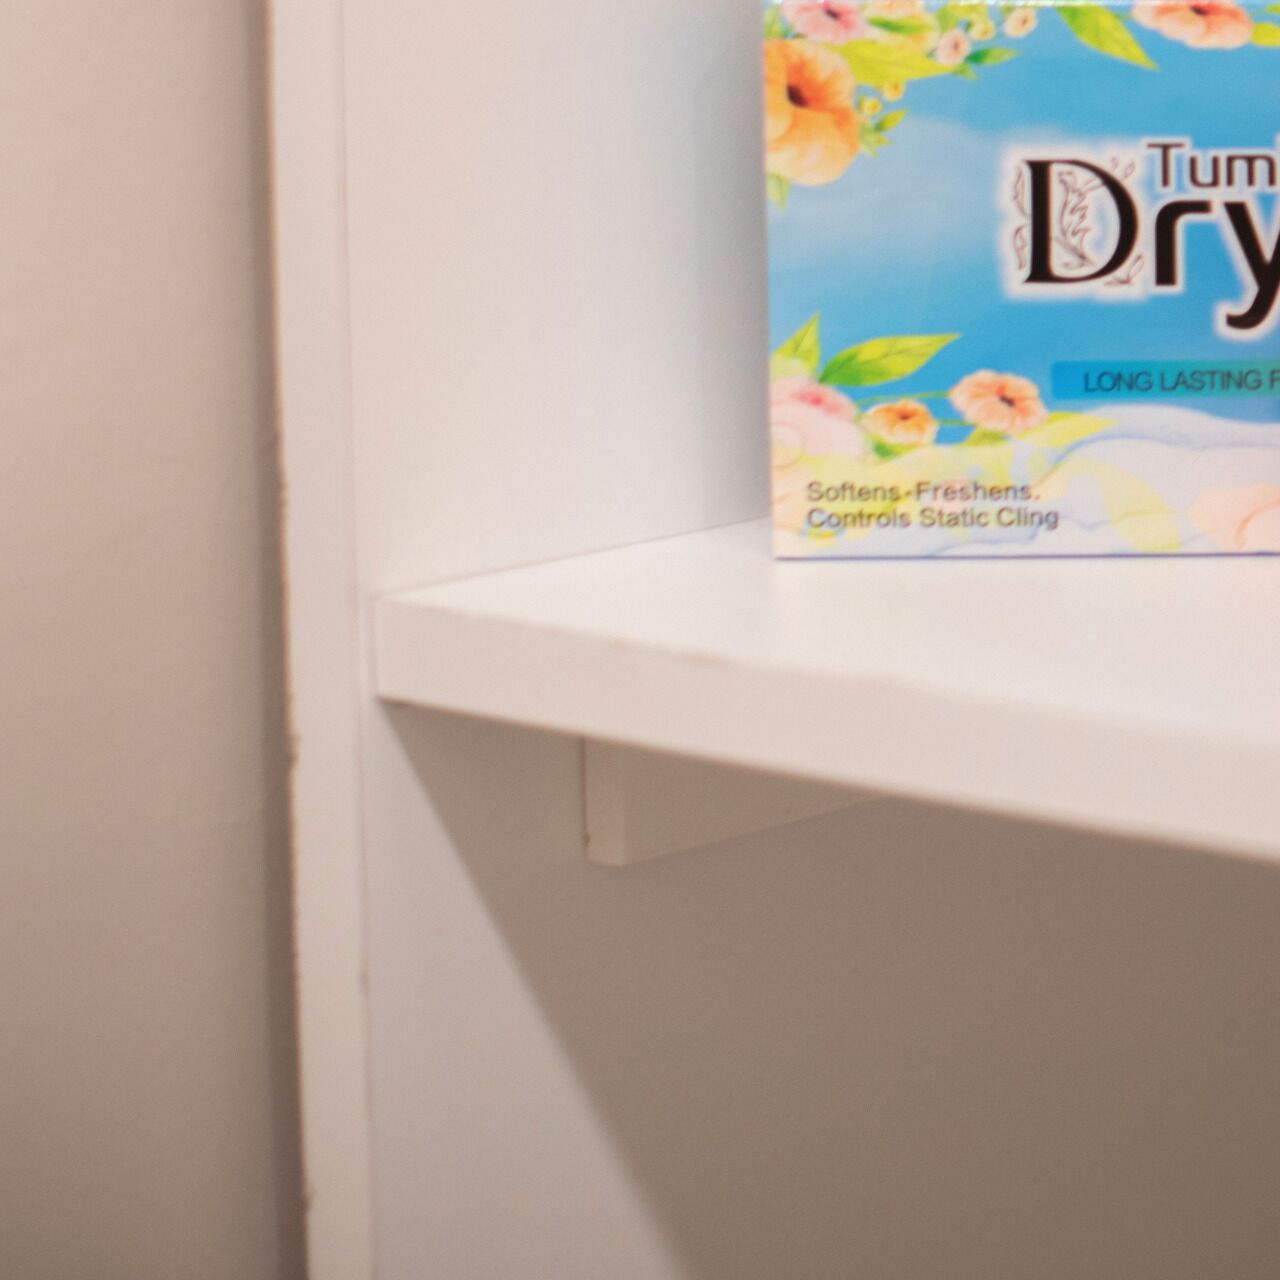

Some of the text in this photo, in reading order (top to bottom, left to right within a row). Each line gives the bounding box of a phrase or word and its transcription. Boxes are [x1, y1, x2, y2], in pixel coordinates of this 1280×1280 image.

[1083, 370, 1153, 394] LONG
[1160, 368, 1263, 393] LASTING
[806, 505, 1060, 531] Controls Static Cling
